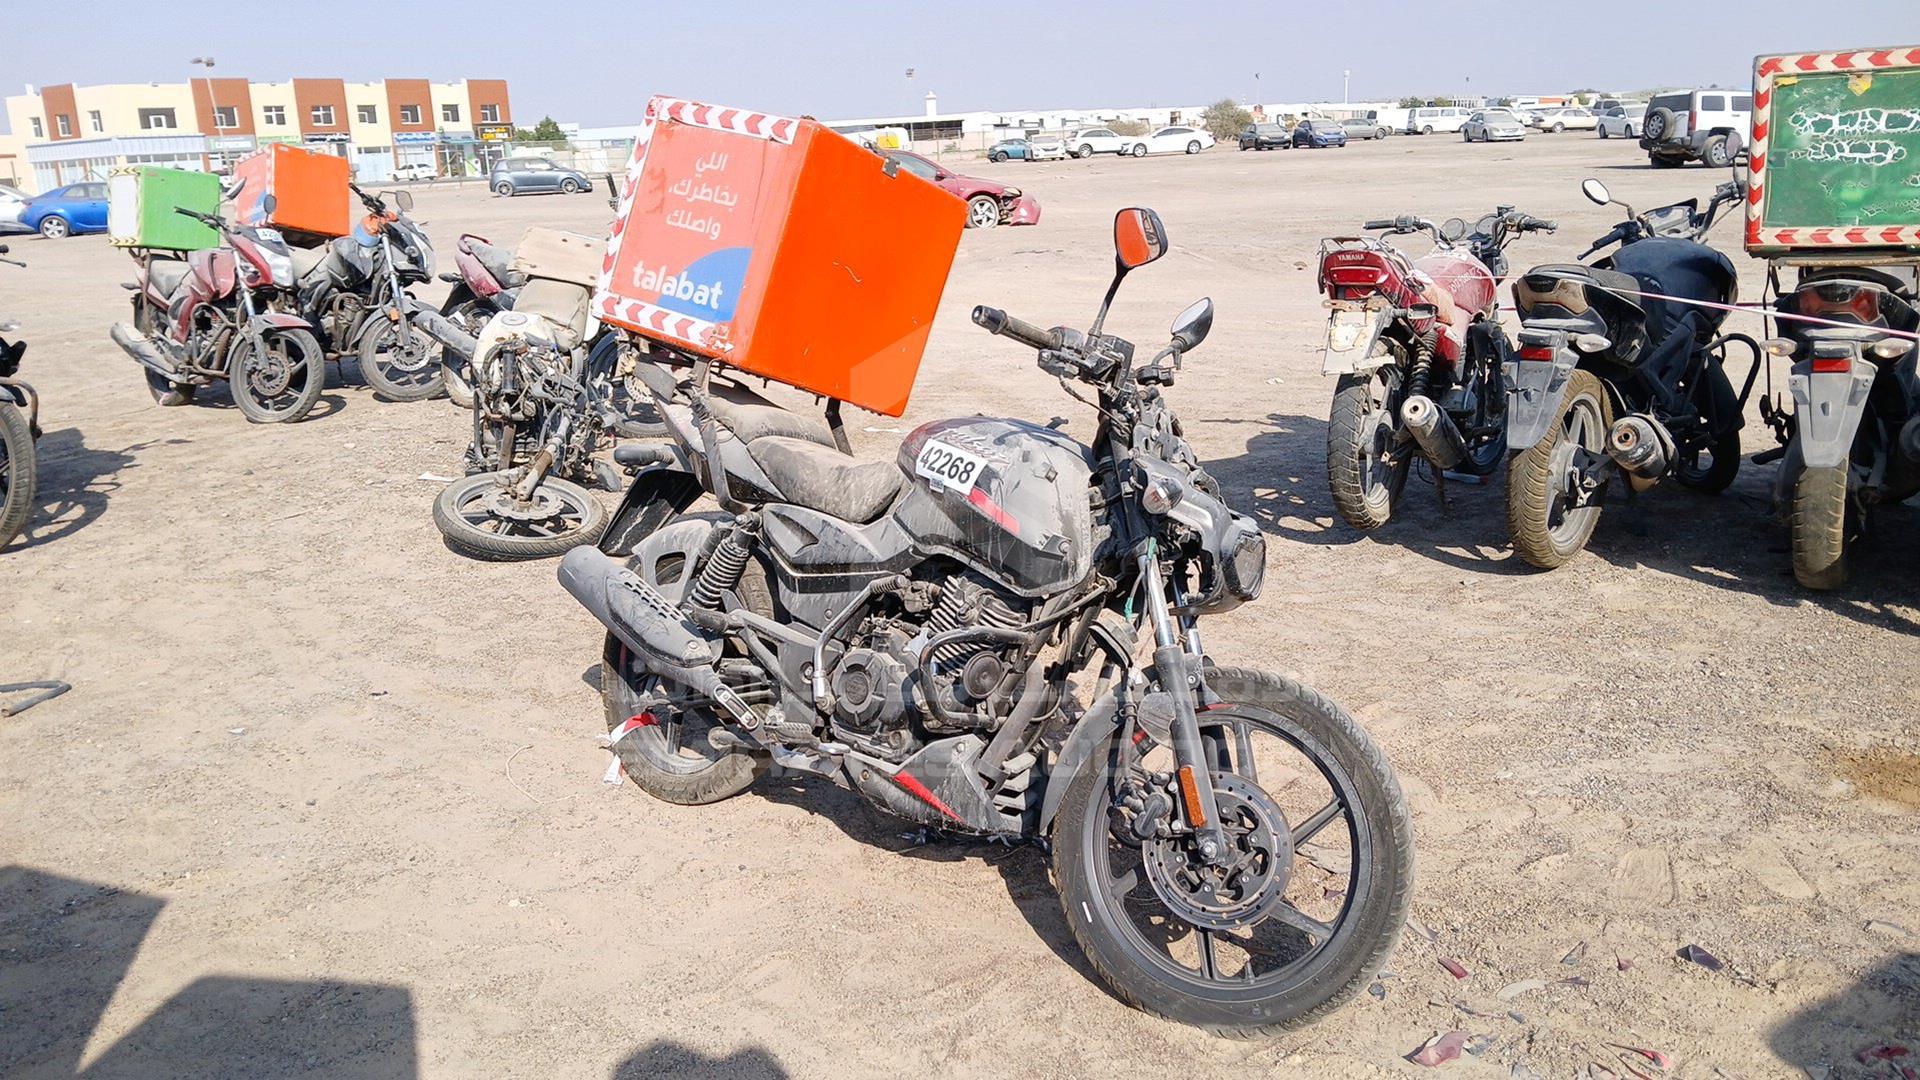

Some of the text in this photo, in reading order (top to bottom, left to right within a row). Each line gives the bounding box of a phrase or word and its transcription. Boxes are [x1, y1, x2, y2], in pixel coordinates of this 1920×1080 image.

[695, 152, 728, 178] اللي
[666, 209, 721, 241] واصلك
[632, 260, 724, 310] talabat
[919, 446, 976, 485] 42268
